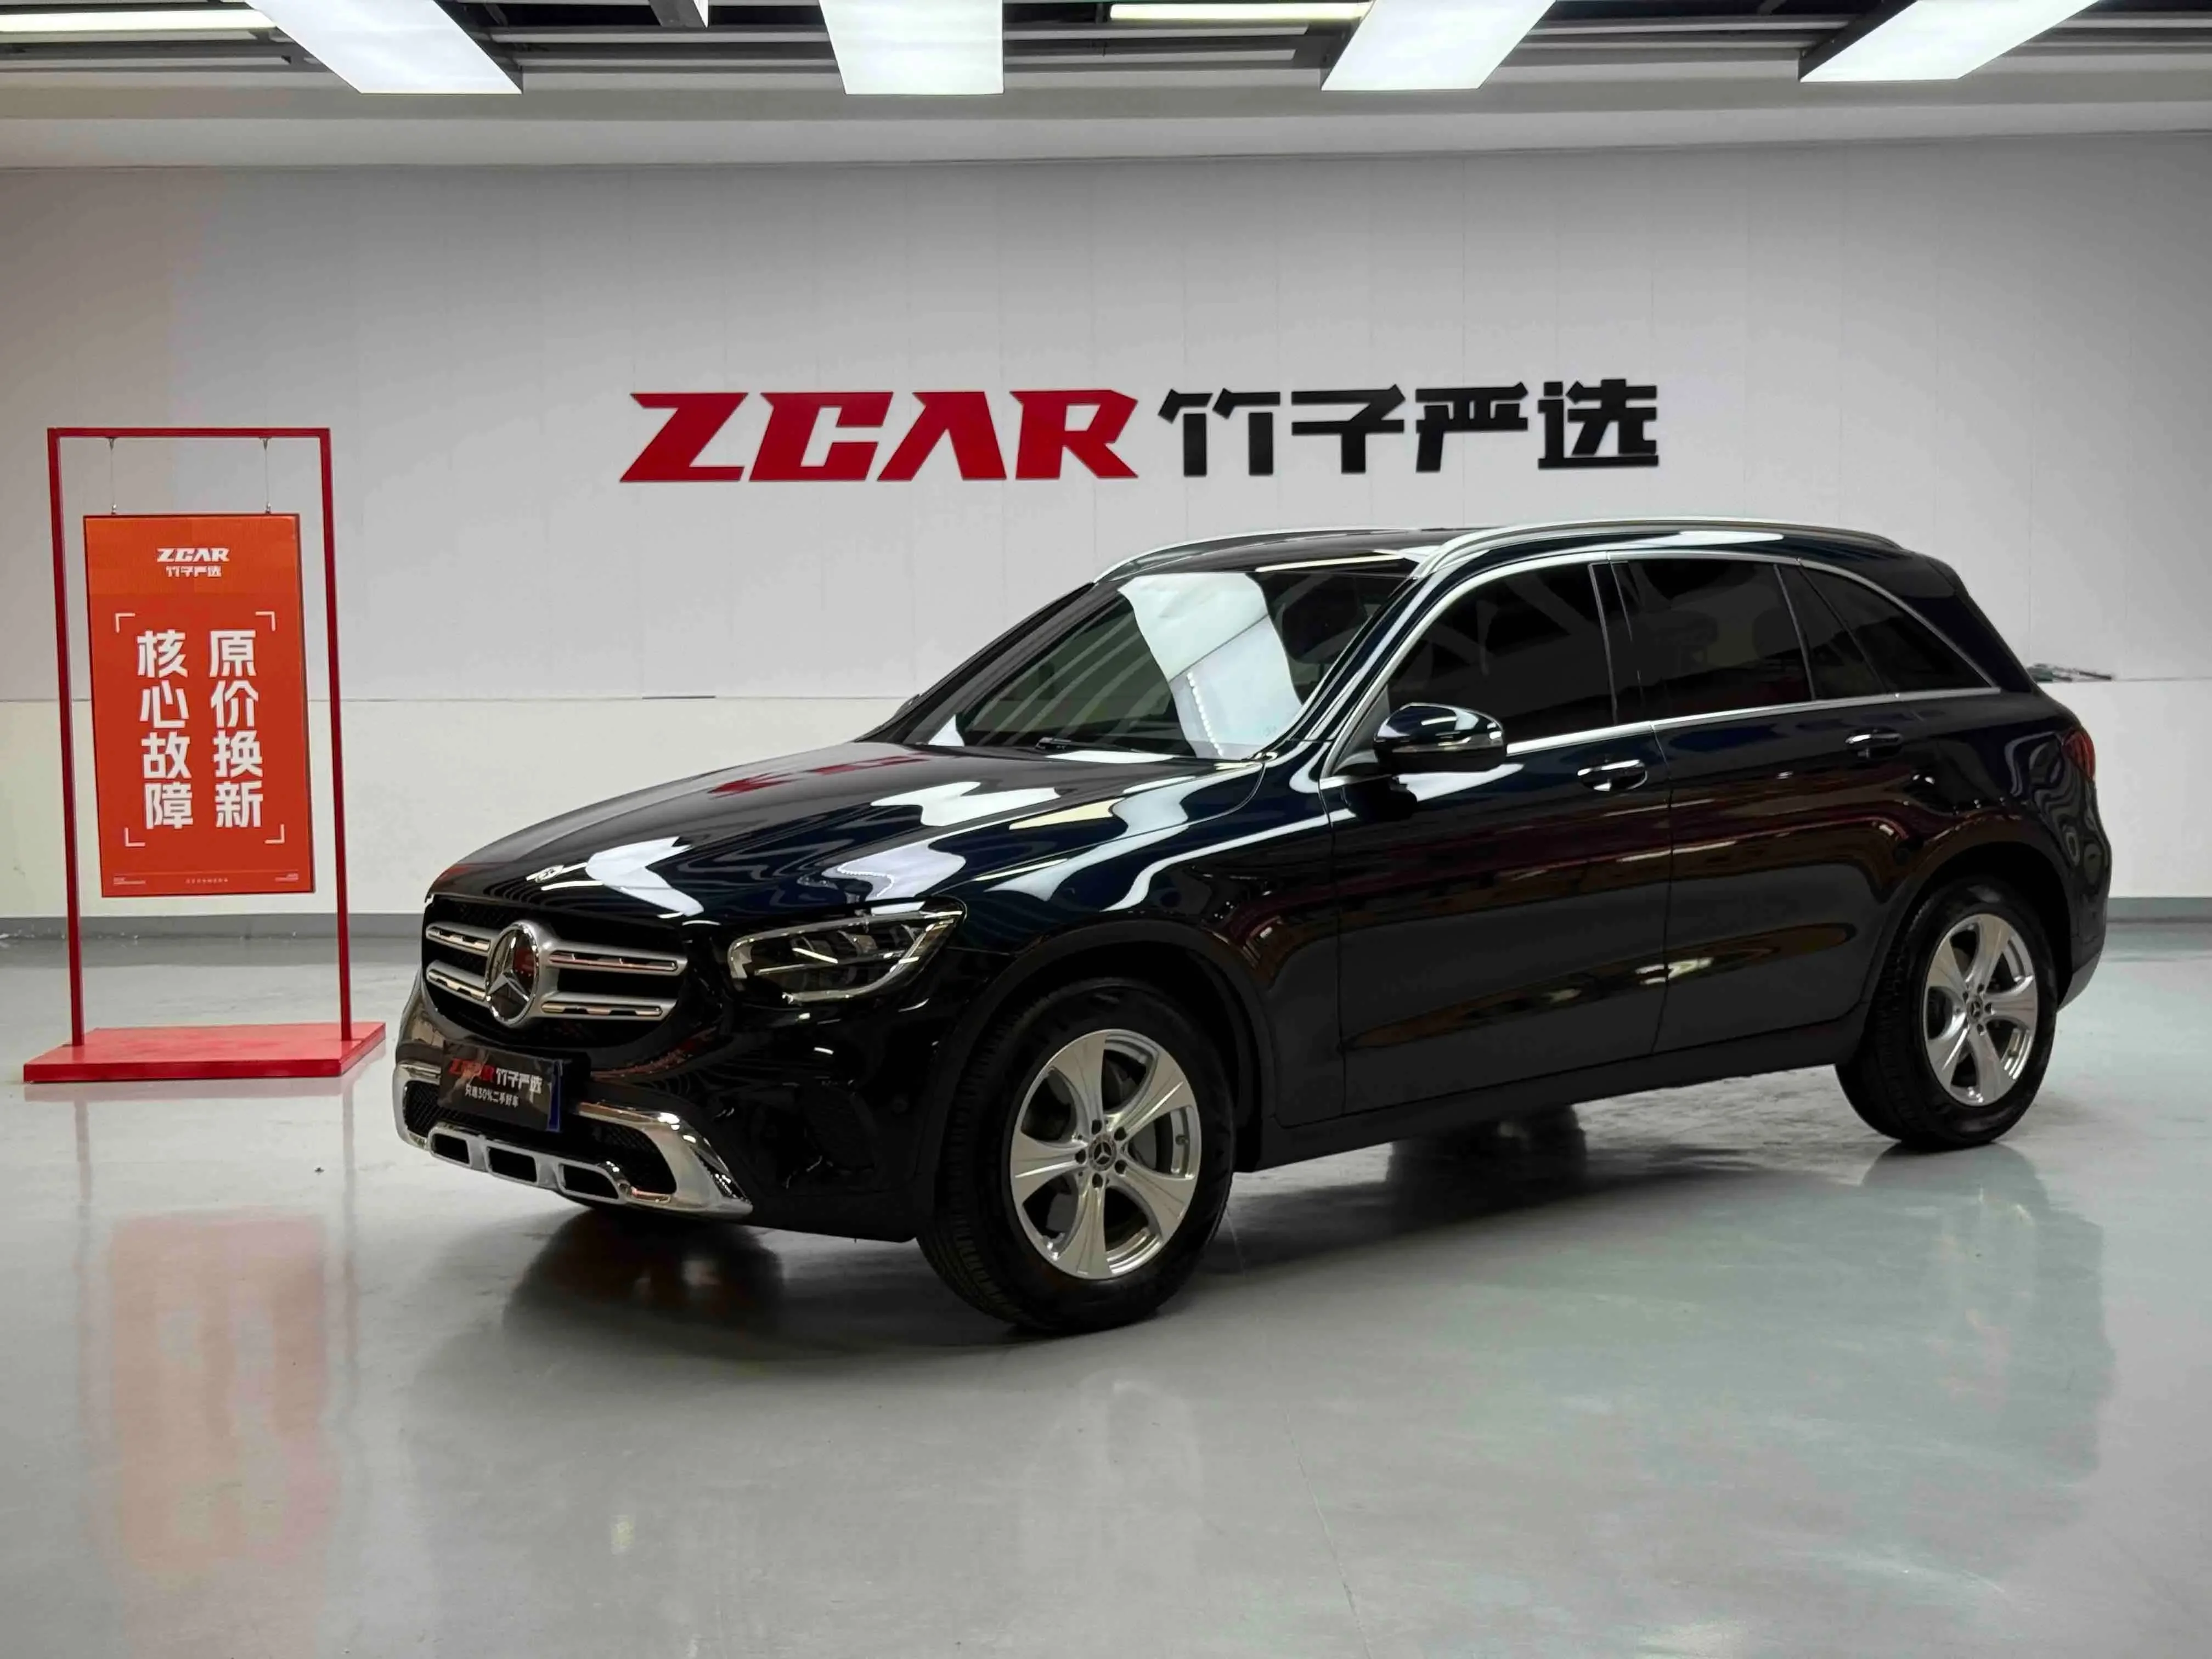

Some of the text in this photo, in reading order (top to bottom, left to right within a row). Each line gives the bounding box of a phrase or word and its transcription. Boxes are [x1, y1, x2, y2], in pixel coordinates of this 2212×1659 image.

[620, 379, 1659, 481] ZCAR 竹子严选
[157, 548, 230, 562] ZCAR
[166, 566, 222, 578] 竹子严选
[137, 630, 193, 830] 核心故障
[209, 629, 263, 828] 原价换新
